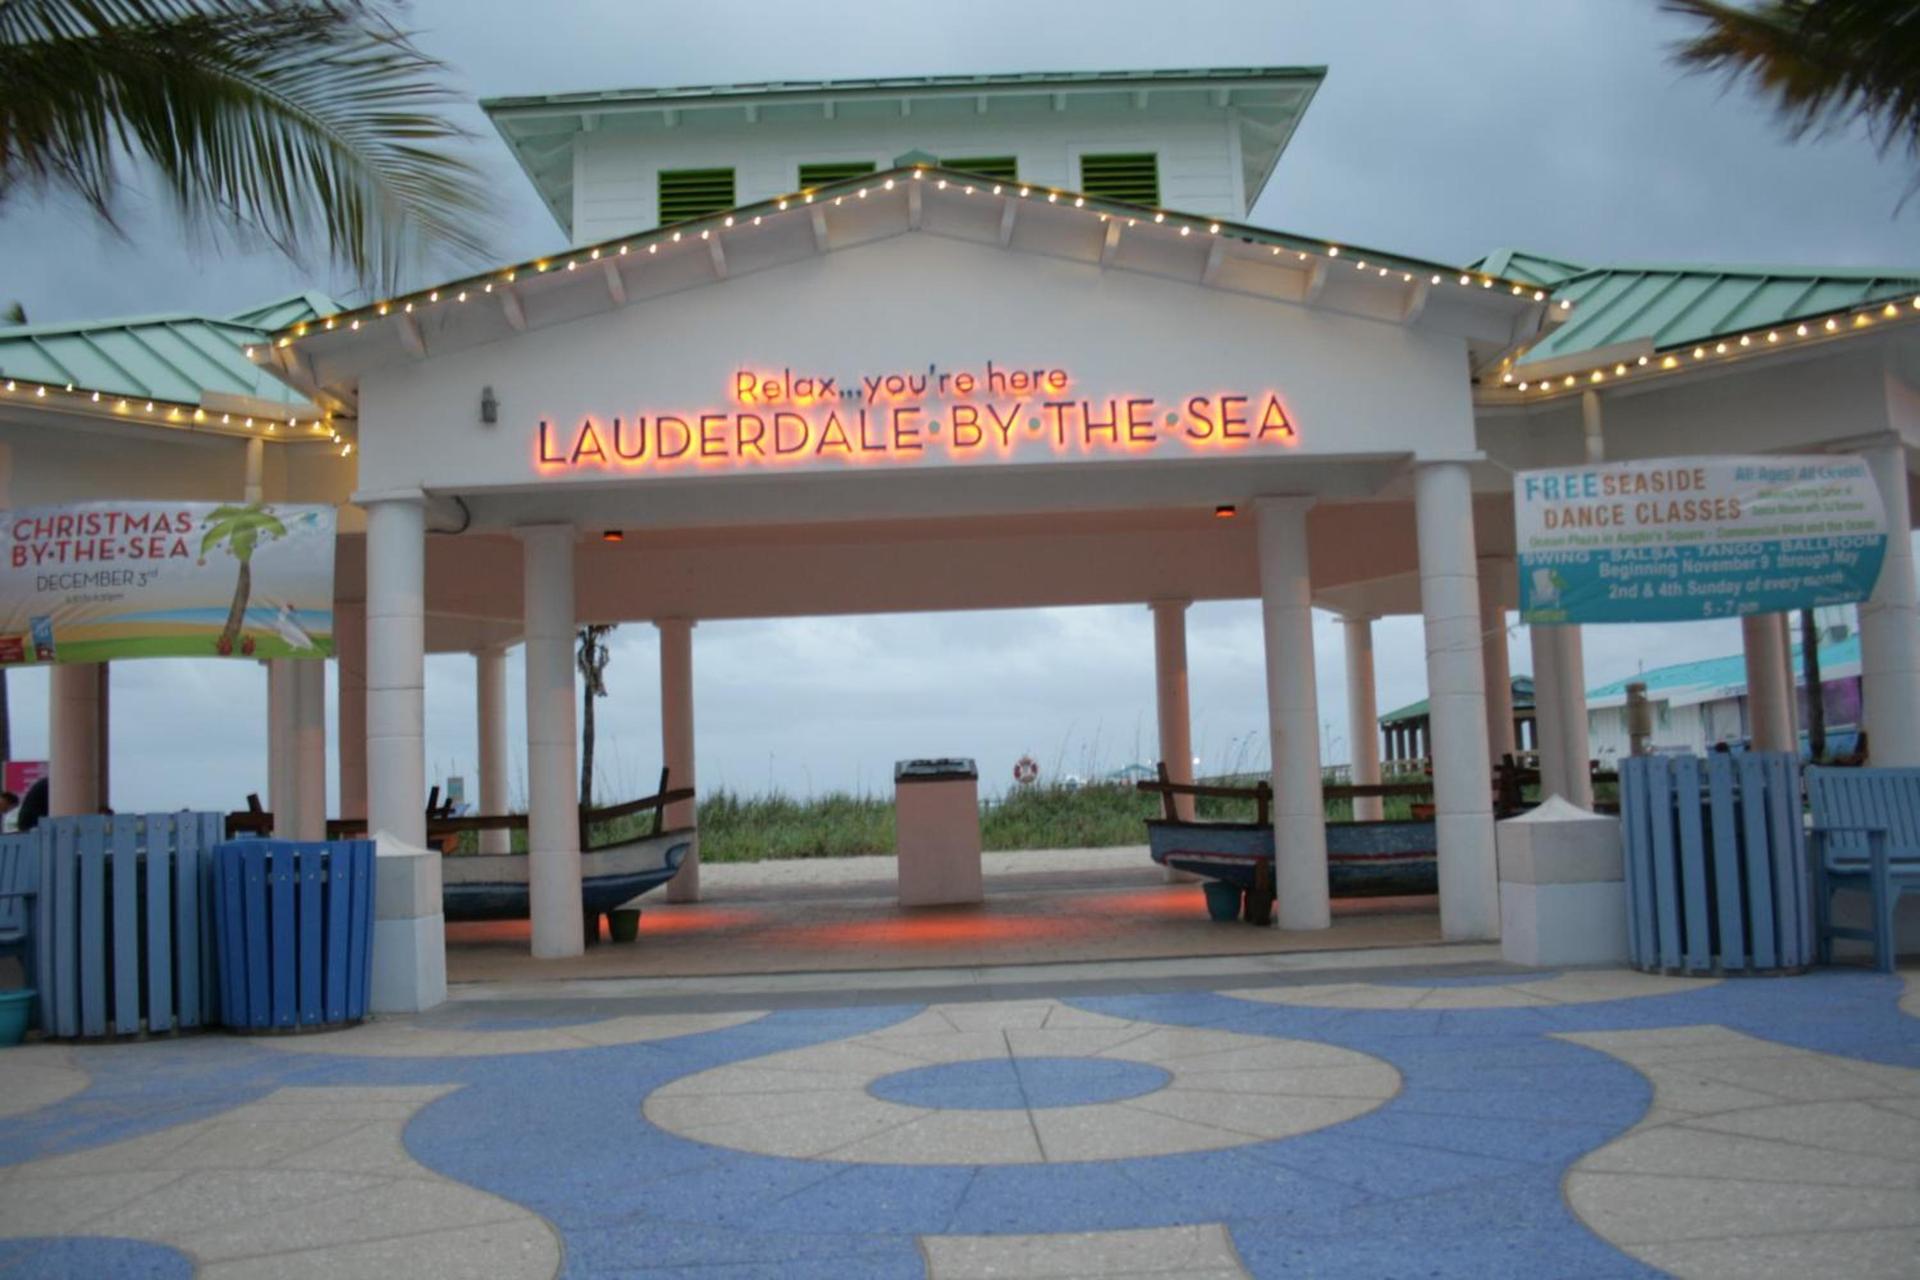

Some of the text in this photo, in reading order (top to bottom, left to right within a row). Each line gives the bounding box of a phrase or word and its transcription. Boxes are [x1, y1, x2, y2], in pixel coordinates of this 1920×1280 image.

[987, 361, 1068, 393] here
[539, 395, 1294, 464] LAUDERDALE BY THE SEA
[1525, 468, 1705, 501] FREE SEASIDE
[12, 512, 193, 541] CHRISTMAS
[1544, 504, 1625, 529] DANCE
[1636, 497, 1742, 525] CLASSES
[1522, 551, 1590, 566] SWING
[1611, 548, 1678, 562] SALSA
[1697, 543, 1763, 557] TANGO
[1780, 535, 1880, 551] BALLROOM
[1599, 560, 1678, 580] Beginning
[1682, 557, 1756, 574] November
[1777, 551, 1830, 568] through
[36, 569, 134, 592] DECEMBER
[1609, 583, 1638, 599] 2nd
[1642, 583, 1654, 598] &
[1659, 580, 1682, 597] 4th
[1687, 578, 1742, 596] Sunday
[1745, 577, 1761, 592] of
[1763, 576, 1802, 592] every
